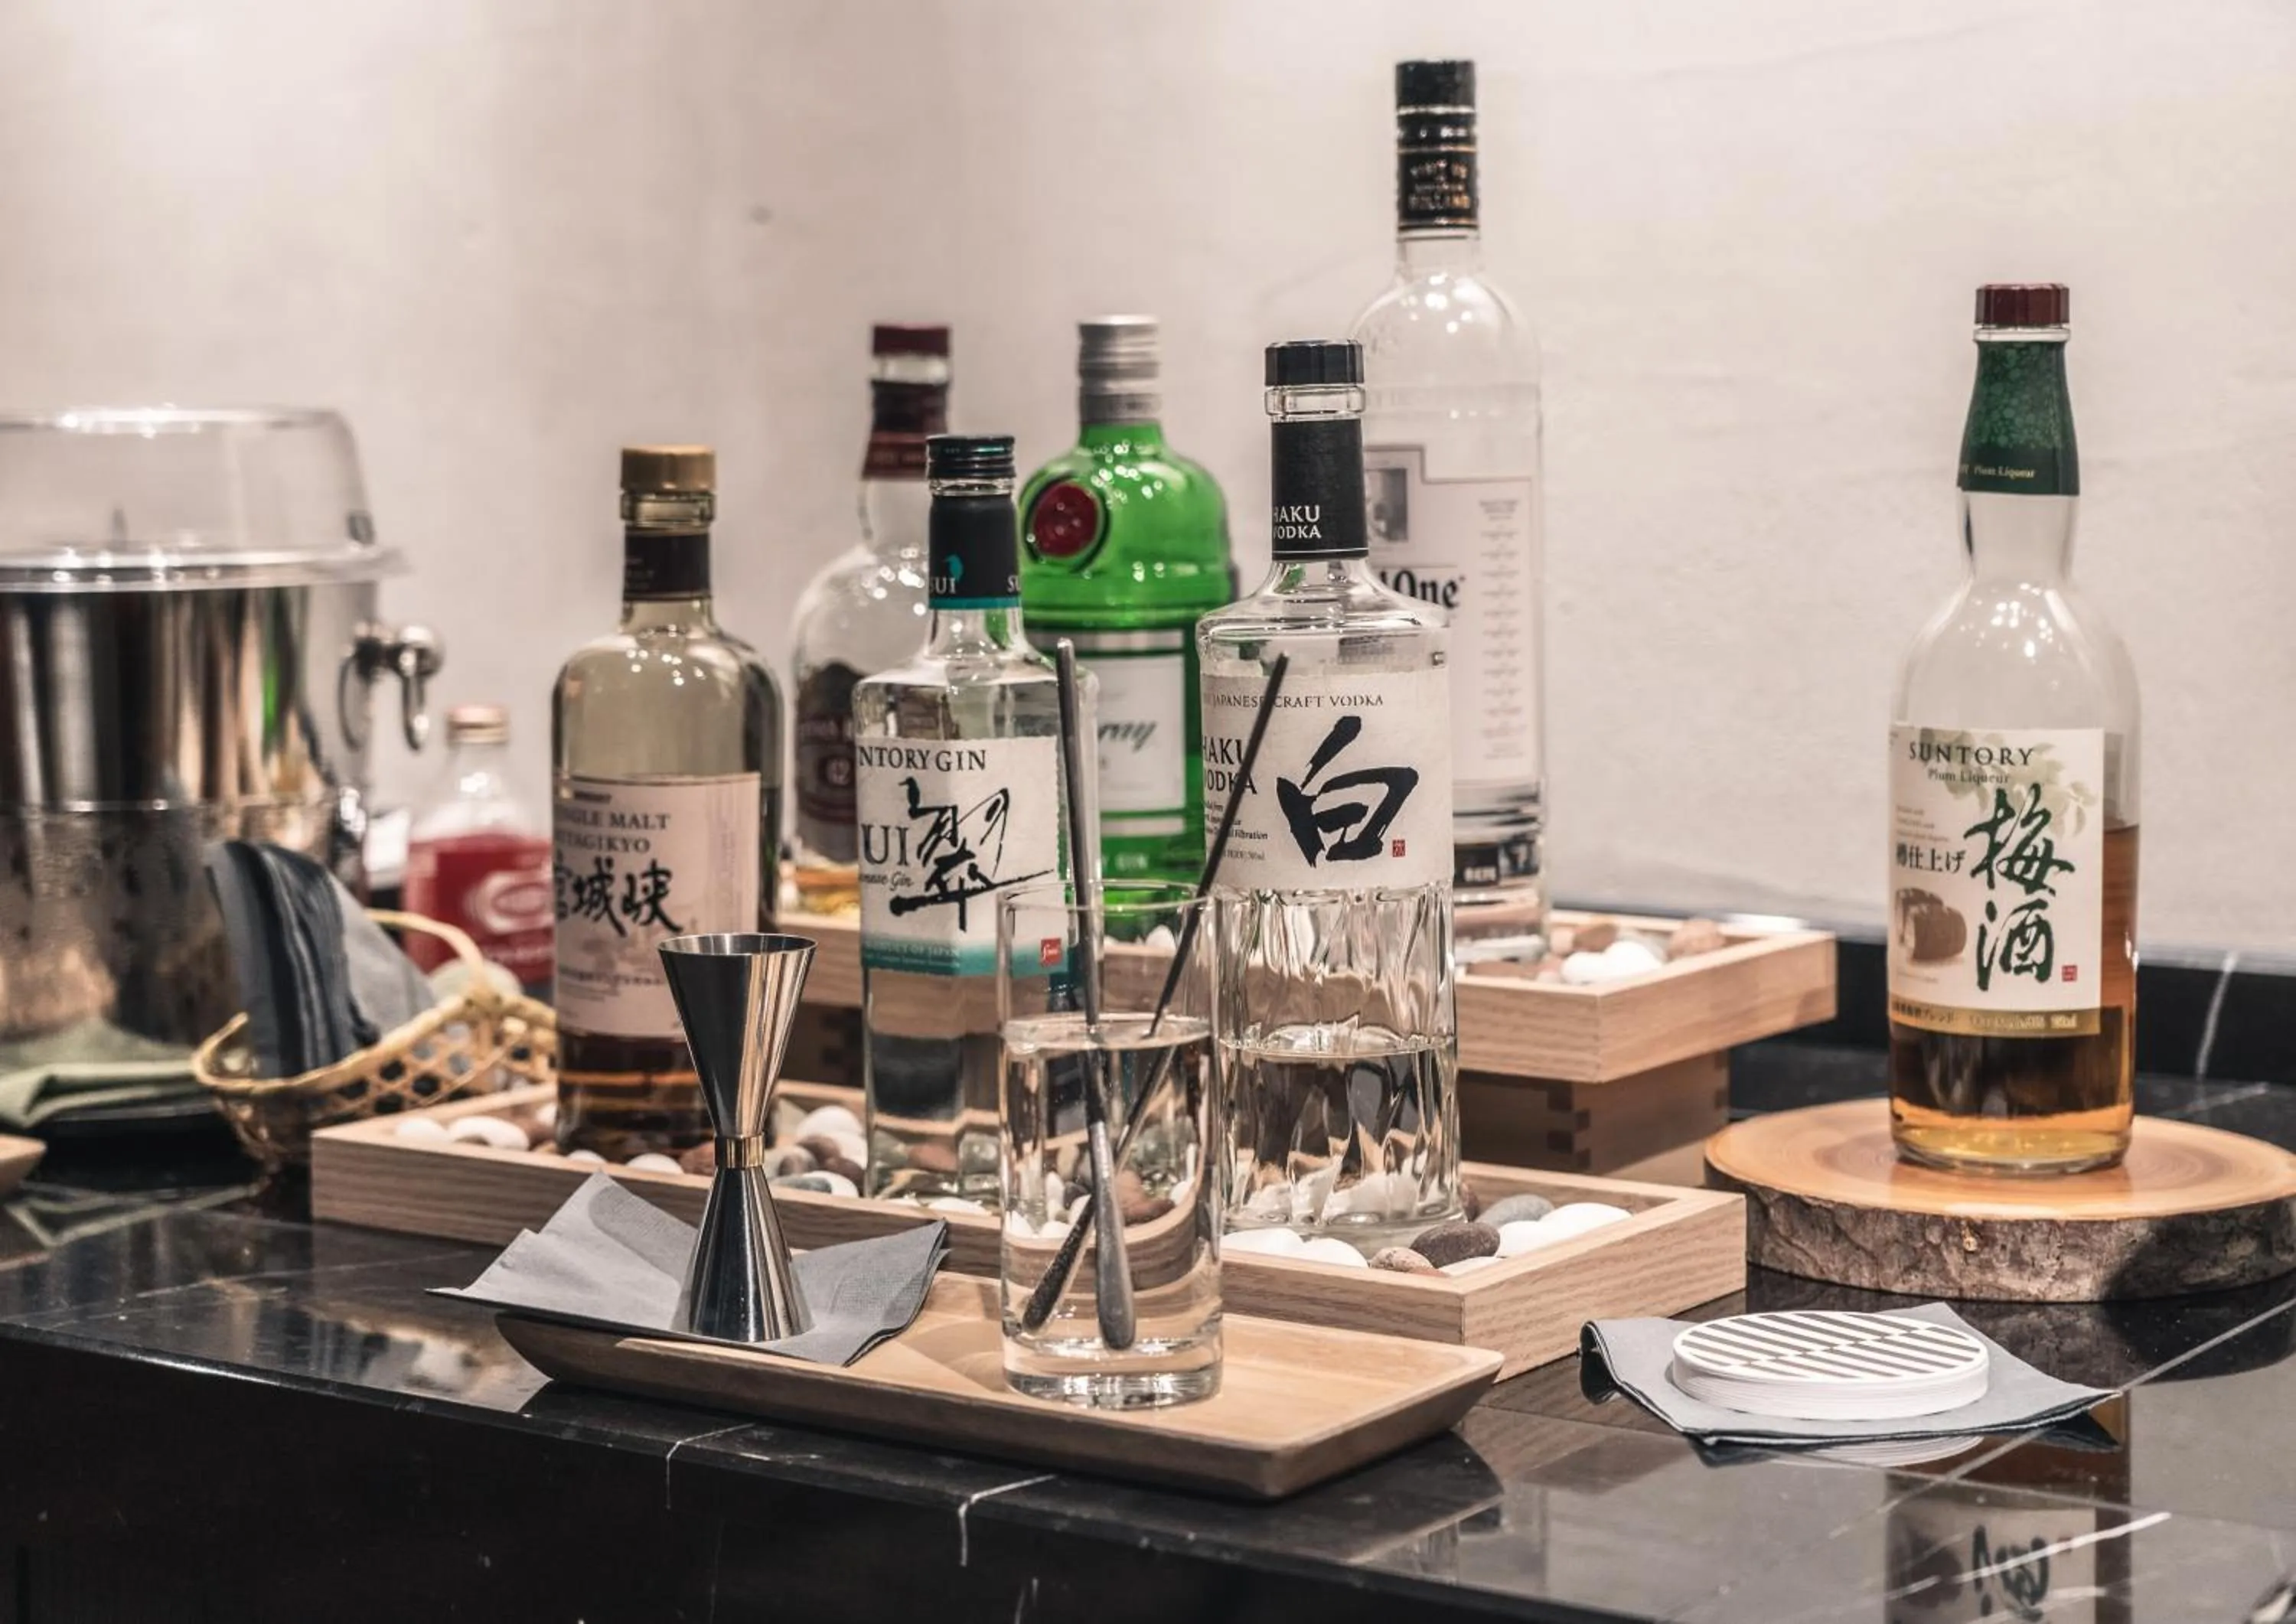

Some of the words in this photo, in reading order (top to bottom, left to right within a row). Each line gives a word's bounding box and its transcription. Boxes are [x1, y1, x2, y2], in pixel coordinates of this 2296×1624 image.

[1274, 695, 1324, 709] CRAFT
[1330, 693, 1384, 709] VODKA
[934, 749, 987, 771] GIN
[1910, 740, 2034, 766] SUNTORY
[1205, 768, 1257, 794] ODKA
[1928, 768, 1956, 782] Plum
[1960, 771, 2010, 785] Liqueur
[1276, 716, 1419, 869] 白
[608, 811, 670, 830] MALT
[1964, 782, 2075, 991] 梅酒
